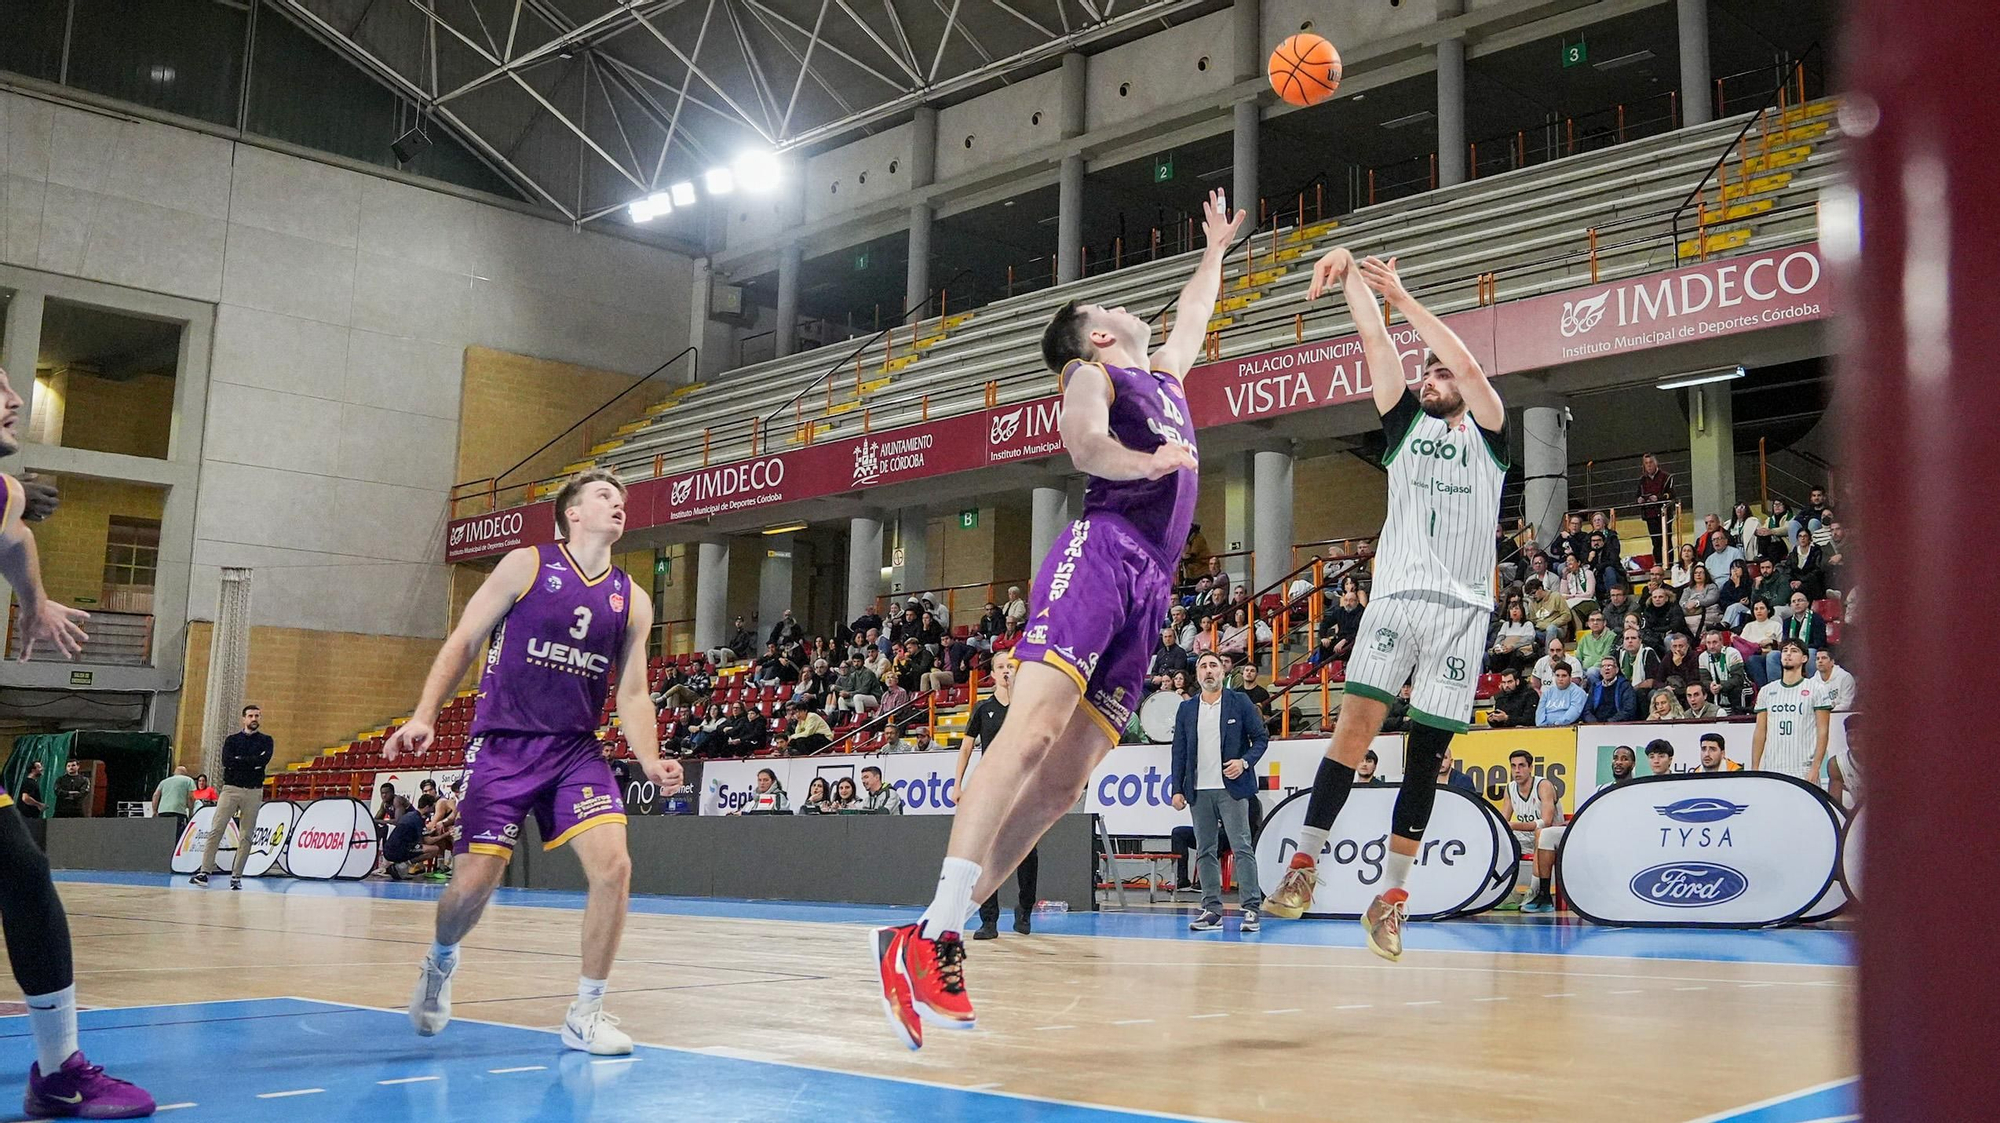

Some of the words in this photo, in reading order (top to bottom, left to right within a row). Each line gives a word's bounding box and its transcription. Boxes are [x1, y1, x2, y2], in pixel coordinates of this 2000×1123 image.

[1569, 47, 1579, 62] 3
[1160, 166, 1168, 179] 2
[859, 257, 864, 268] 1
[1616, 251, 1820, 326] IMDECO
[1562, 341, 1611, 359] Instituto
[1614, 327, 1675, 350] Municipal
[1678, 325, 1695, 338] de
[1698, 314, 1759, 334] Deportes
[1761, 303, 1820, 322] Córdoba
[1238, 354, 1294, 377] PALACIO
[1297, 340, 1366, 367] MUNICIPA
[1224, 371, 1316, 418] VISTA
[1026, 400, 1060, 438] IM
[880, 434, 933, 457] AYUNTAMIENTO
[990, 447, 1021, 461] Instituto
[1022, 439, 1061, 455] Municipal
[1411, 438, 1457, 460] coto
[880, 460, 889, 474] DE
[889, 453, 925, 472] CÓRDOBA
[695, 457, 785, 501] IMDECO
[1436, 482, 1472, 495] Cajasol
[670, 511, 692, 520] Instituto
[692, 503, 721, 516] Municipal
[720, 502, 728, 511] de
[729, 498, 757, 510] Deportes
[756, 492, 782, 504] Córdoba
[465, 512, 523, 542] IMDECO
[964, 512, 973, 526] B
[658, 562, 665, 572] A
[1049, 520, 1090, 601] 2015-2025
[569, 605, 592, 640] 3
[527, 637, 609, 673] UENC
[1771, 702, 1796, 713] coto
[1779, 720, 1793, 736] 90
[718, 784, 753, 809] Sepi
[297, 826, 346, 850] CÓRDOBA
[1660, 826, 1733, 848] TYSA
[1651, 868, 1725, 899] Ford
